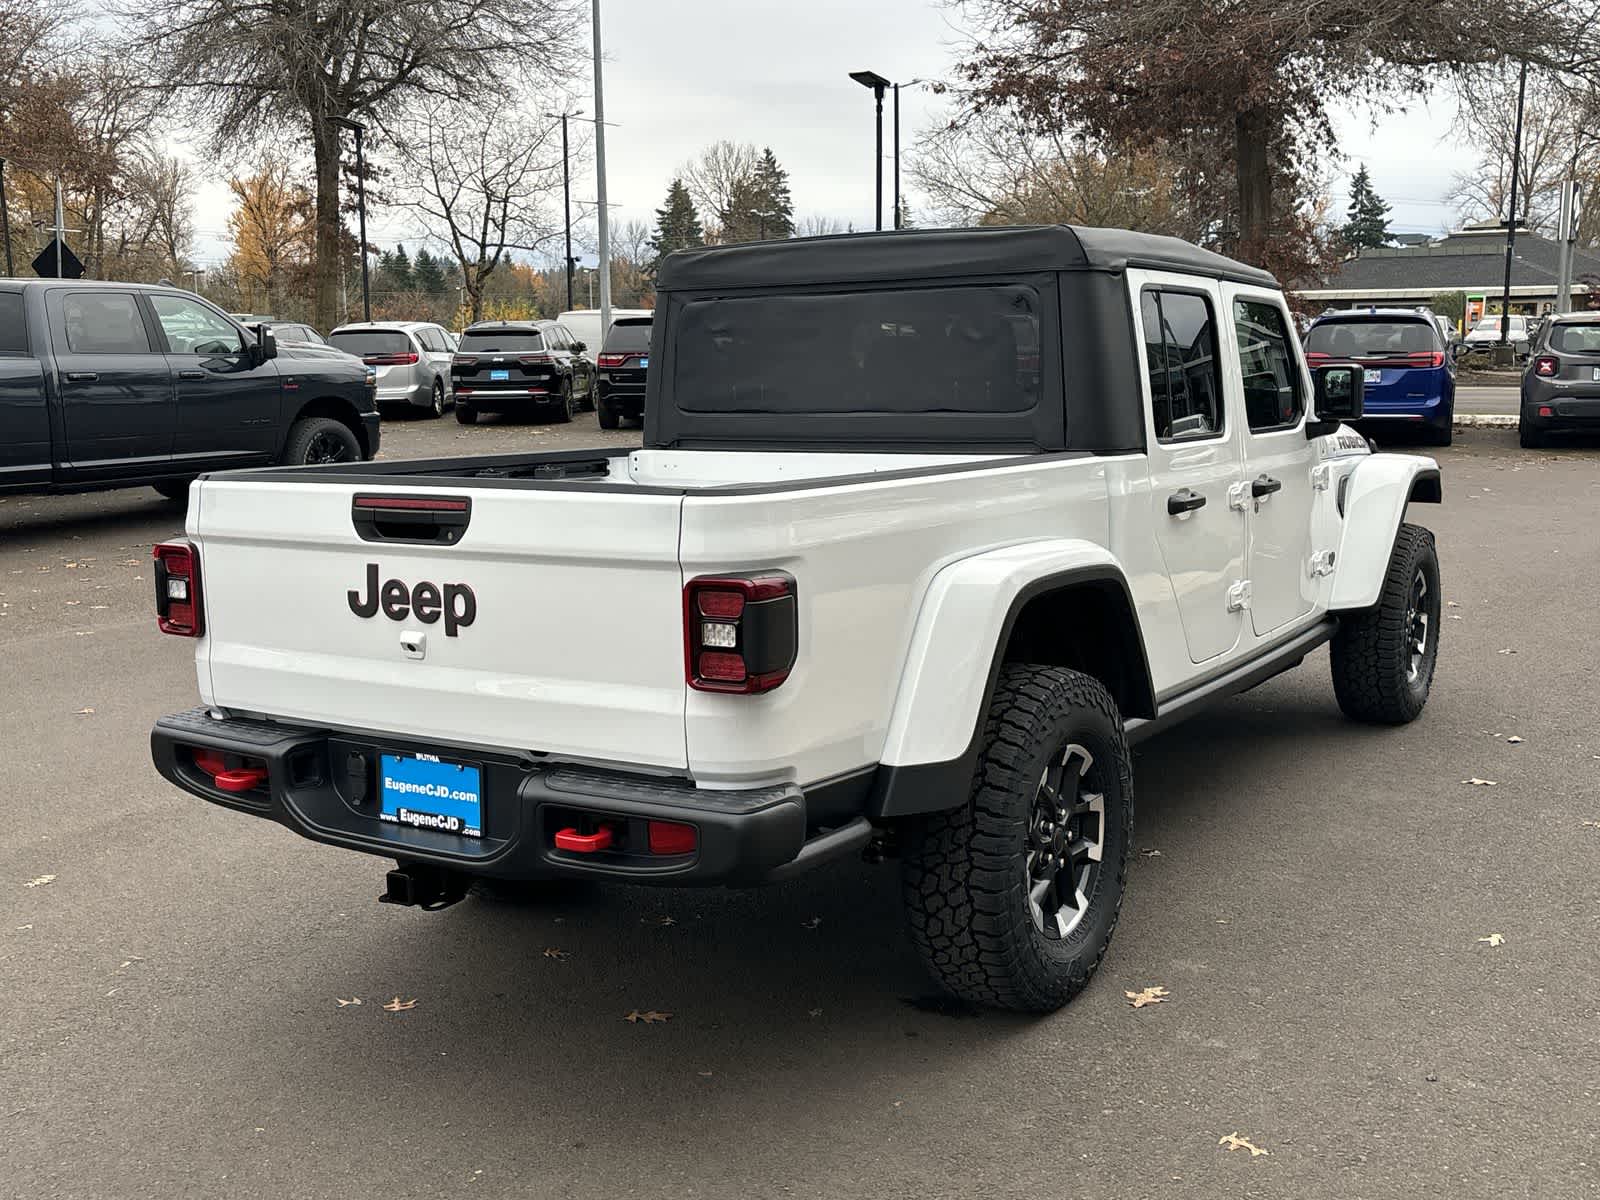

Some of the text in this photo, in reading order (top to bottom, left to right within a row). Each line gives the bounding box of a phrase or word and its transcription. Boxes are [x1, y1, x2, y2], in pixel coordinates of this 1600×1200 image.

[347, 563, 477, 637] Jeep
[384, 777, 478, 803] EugeneCJD.com
[400, 808, 459, 830] EugeneCJD
